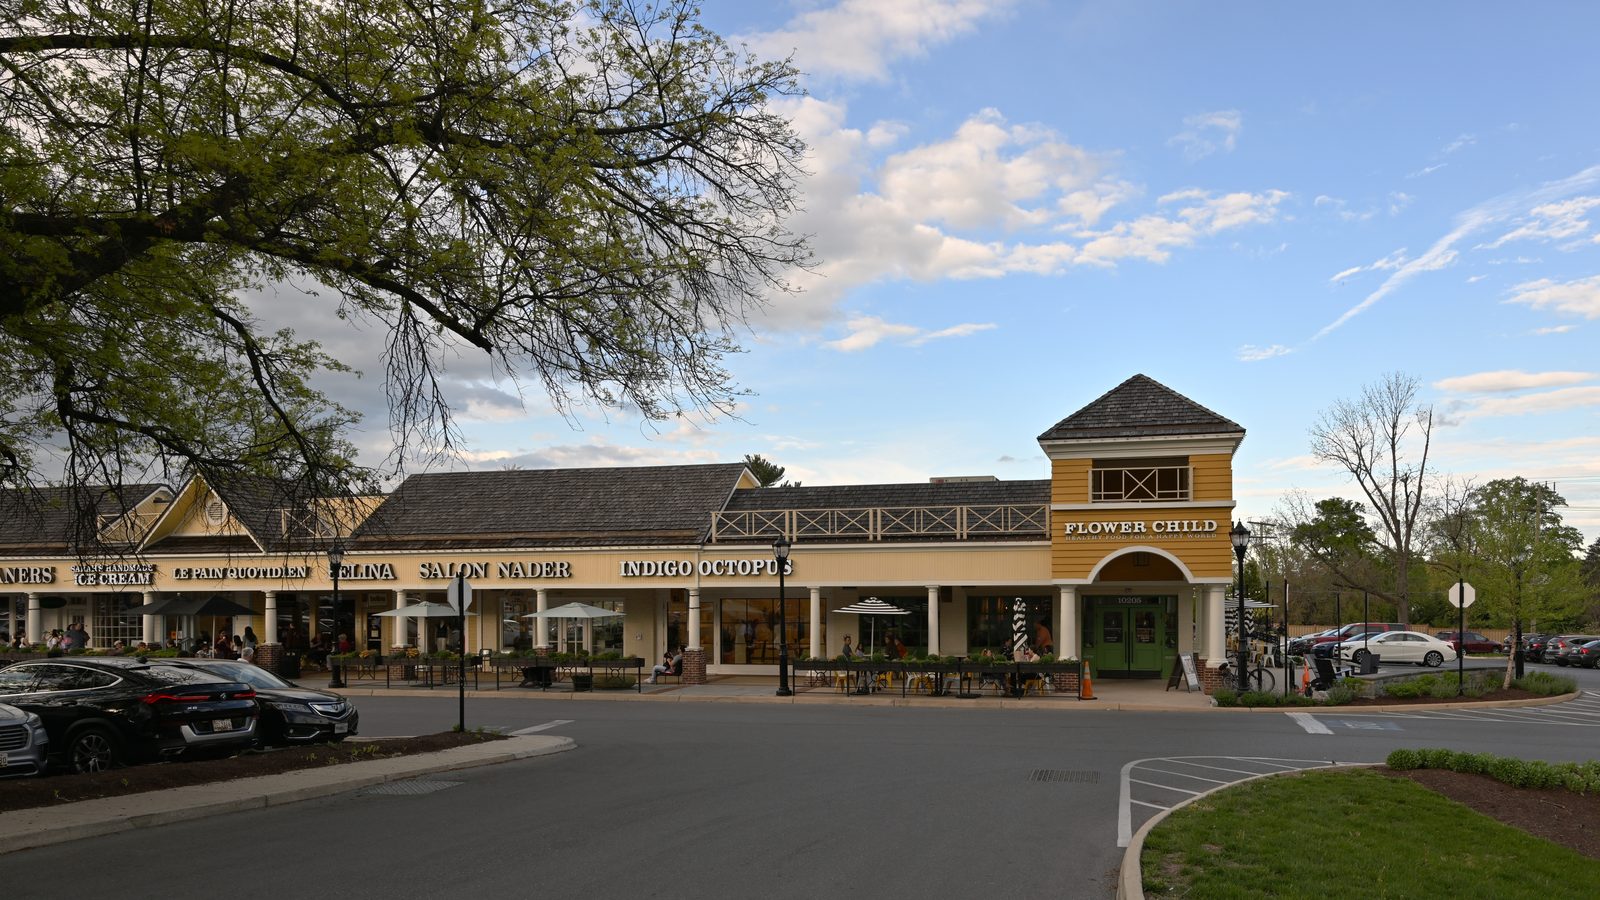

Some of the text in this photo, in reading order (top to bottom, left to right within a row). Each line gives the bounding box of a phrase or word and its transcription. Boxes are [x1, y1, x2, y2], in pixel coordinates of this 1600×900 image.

[1064, 520, 1218, 534] FLOWER CHILD
[0, 567, 53, 584] NERS
[105, 563, 154, 573] HANDMADE
[172, 566, 307, 579] LE PAIN QUOTIDIEN
[329, 563, 395, 580] ELINA
[419, 561, 571, 579] SALON NADER
[619, 559, 792, 577] INDIGO OCTOPUS
[73, 572, 151, 585] ICE CREAM
